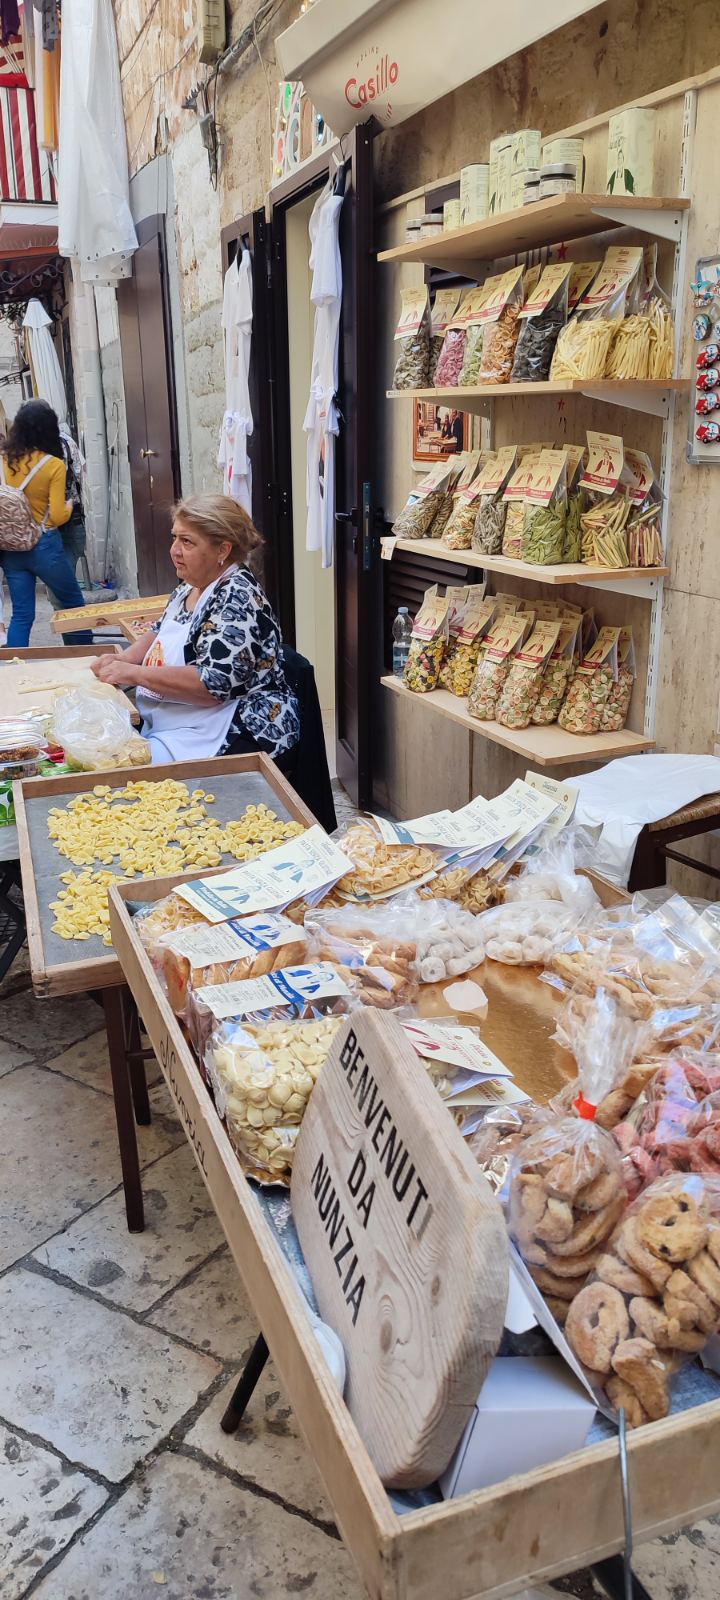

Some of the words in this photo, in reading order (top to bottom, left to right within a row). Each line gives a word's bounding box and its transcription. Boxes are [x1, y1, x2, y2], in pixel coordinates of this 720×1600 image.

[345, 54, 398, 109] Casillo
[338, 1028, 434, 1240] BENVENUTI
[347, 1150, 376, 1230] DA
[311, 1153, 367, 1327] NUNZIA
